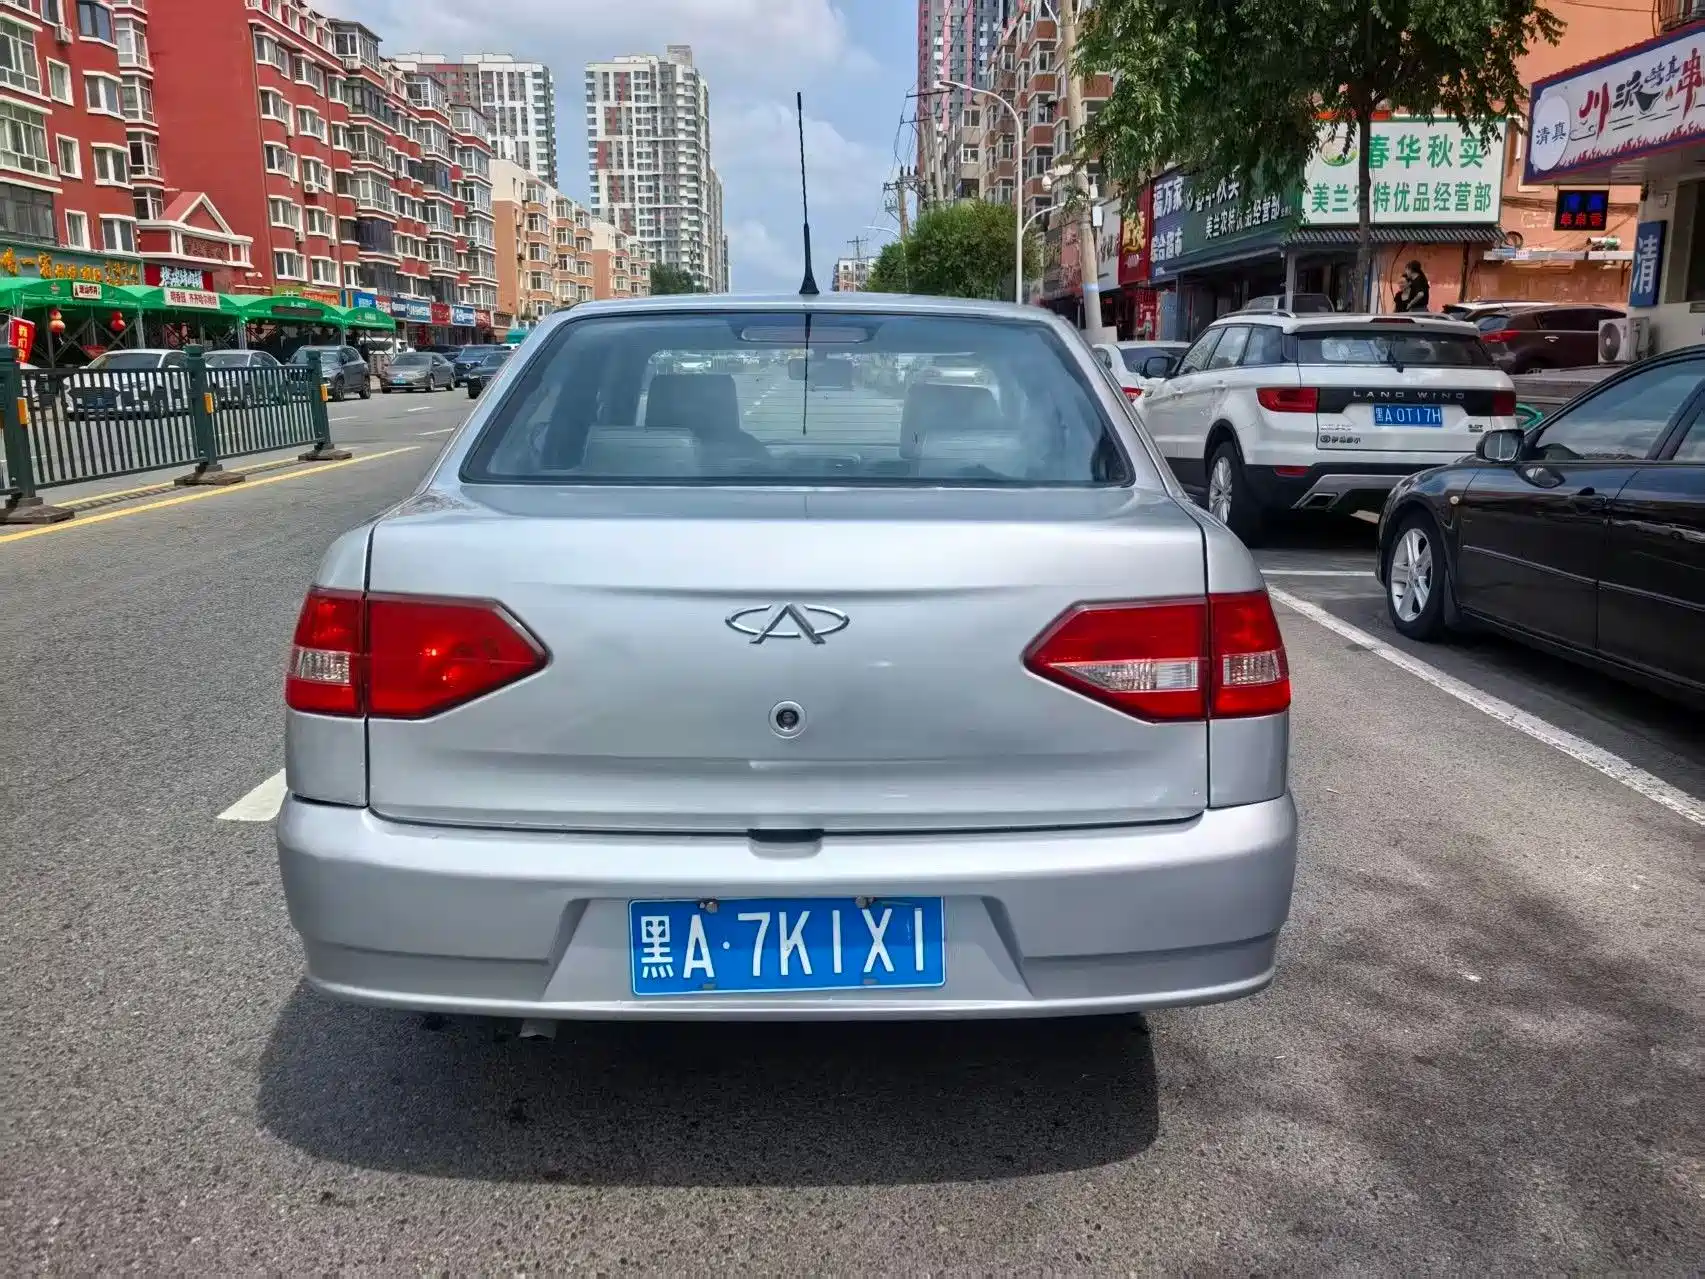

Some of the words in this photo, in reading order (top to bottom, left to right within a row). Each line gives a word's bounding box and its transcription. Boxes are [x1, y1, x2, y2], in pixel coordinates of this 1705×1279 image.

[1369, 134, 1484, 168] 春华秋实
[1535, 122, 1567, 146] 清真
[1153, 176, 1185, 220] 福万家
[1632, 233, 1659, 295] 清
[1353, 390, 1405, 398] LAND
